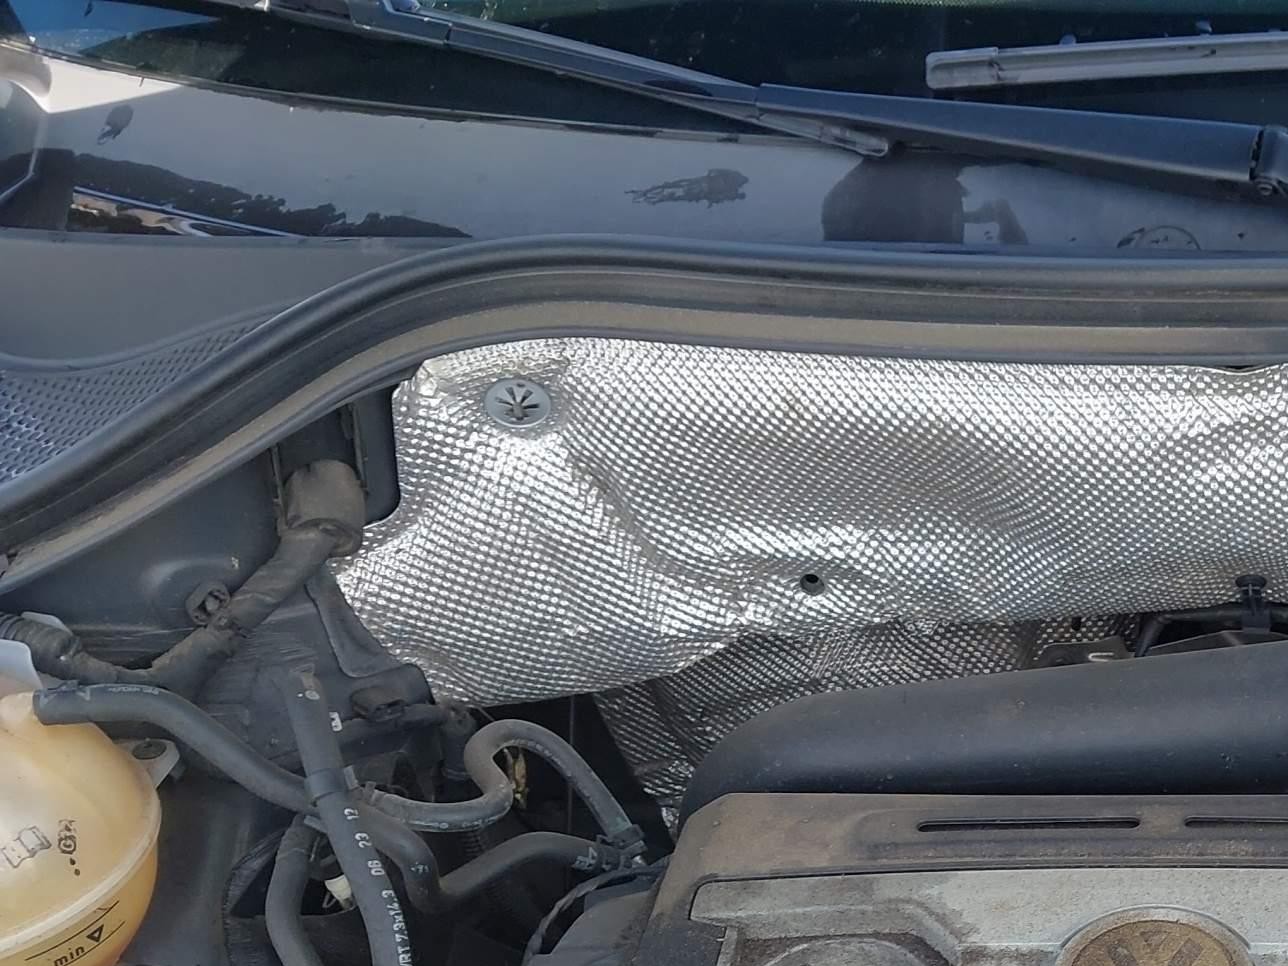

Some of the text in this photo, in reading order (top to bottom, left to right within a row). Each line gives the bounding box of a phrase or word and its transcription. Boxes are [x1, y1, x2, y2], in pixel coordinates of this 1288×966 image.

[344, 808, 360, 820] 12
[354, 832, 372, 848] 23
[367, 860, 385, 876] 06
